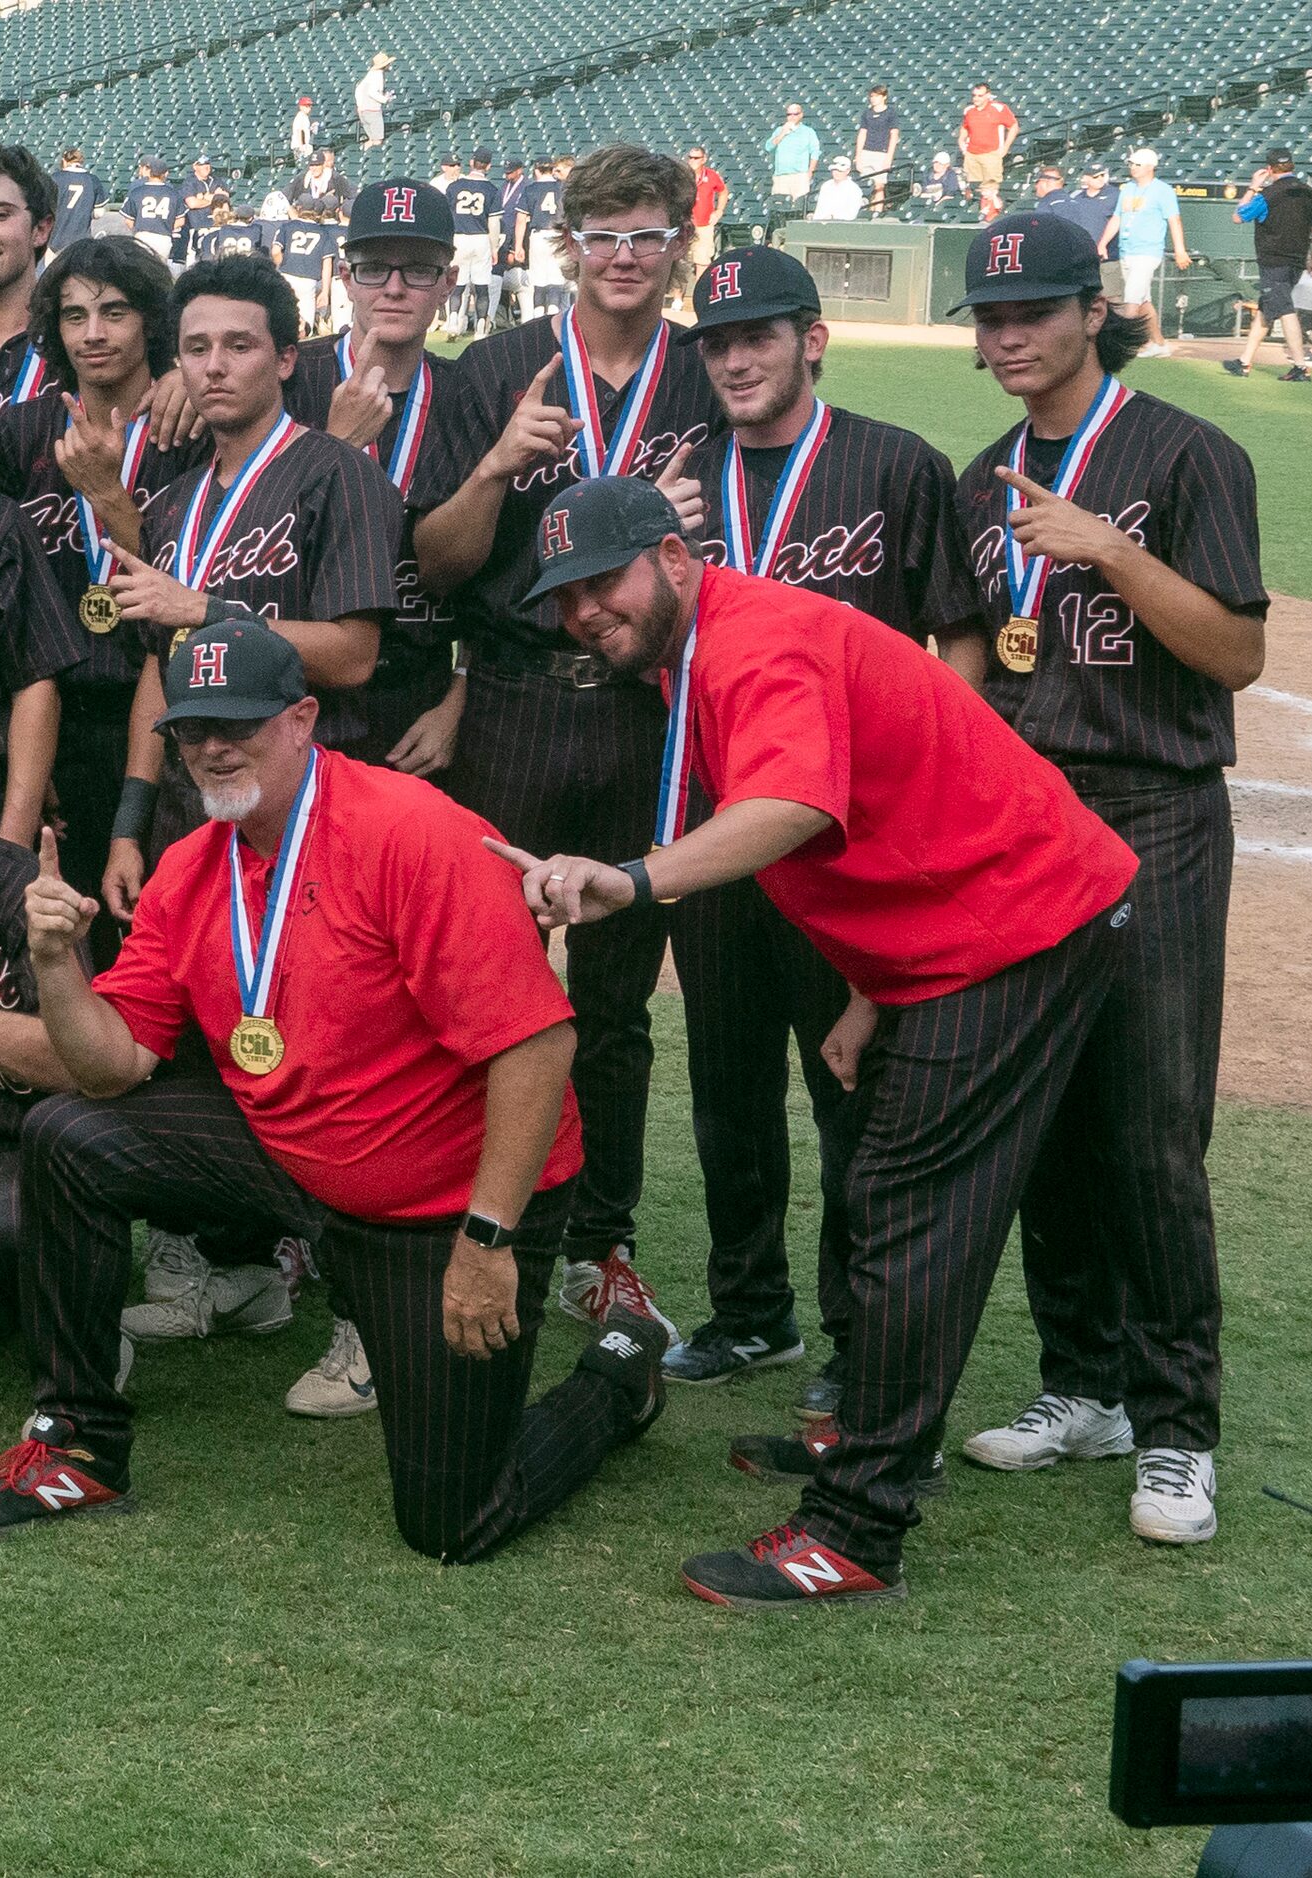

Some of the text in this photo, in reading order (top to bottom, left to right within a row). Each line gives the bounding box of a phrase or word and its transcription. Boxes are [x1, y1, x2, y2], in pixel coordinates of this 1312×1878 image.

[66, 184, 84, 209] 7
[141, 196, 170, 220] 24
[379, 187, 417, 223] H
[455, 189, 485, 216] 23
[540, 191, 557, 215] 4
[289, 230, 321, 256] 27
[985, 232, 1025, 277] H
[708, 261, 742, 304] H
[542, 508, 574, 561] H
[85, 597, 115, 618] UIL
[1005, 630, 1036, 654] UIL
[1057, 592, 1135, 666] 12
[188, 641, 229, 688] H
[239, 1031, 275, 1057] UIL
[35, 1472, 86, 1511] N
[783, 1551, 843, 1595] N
